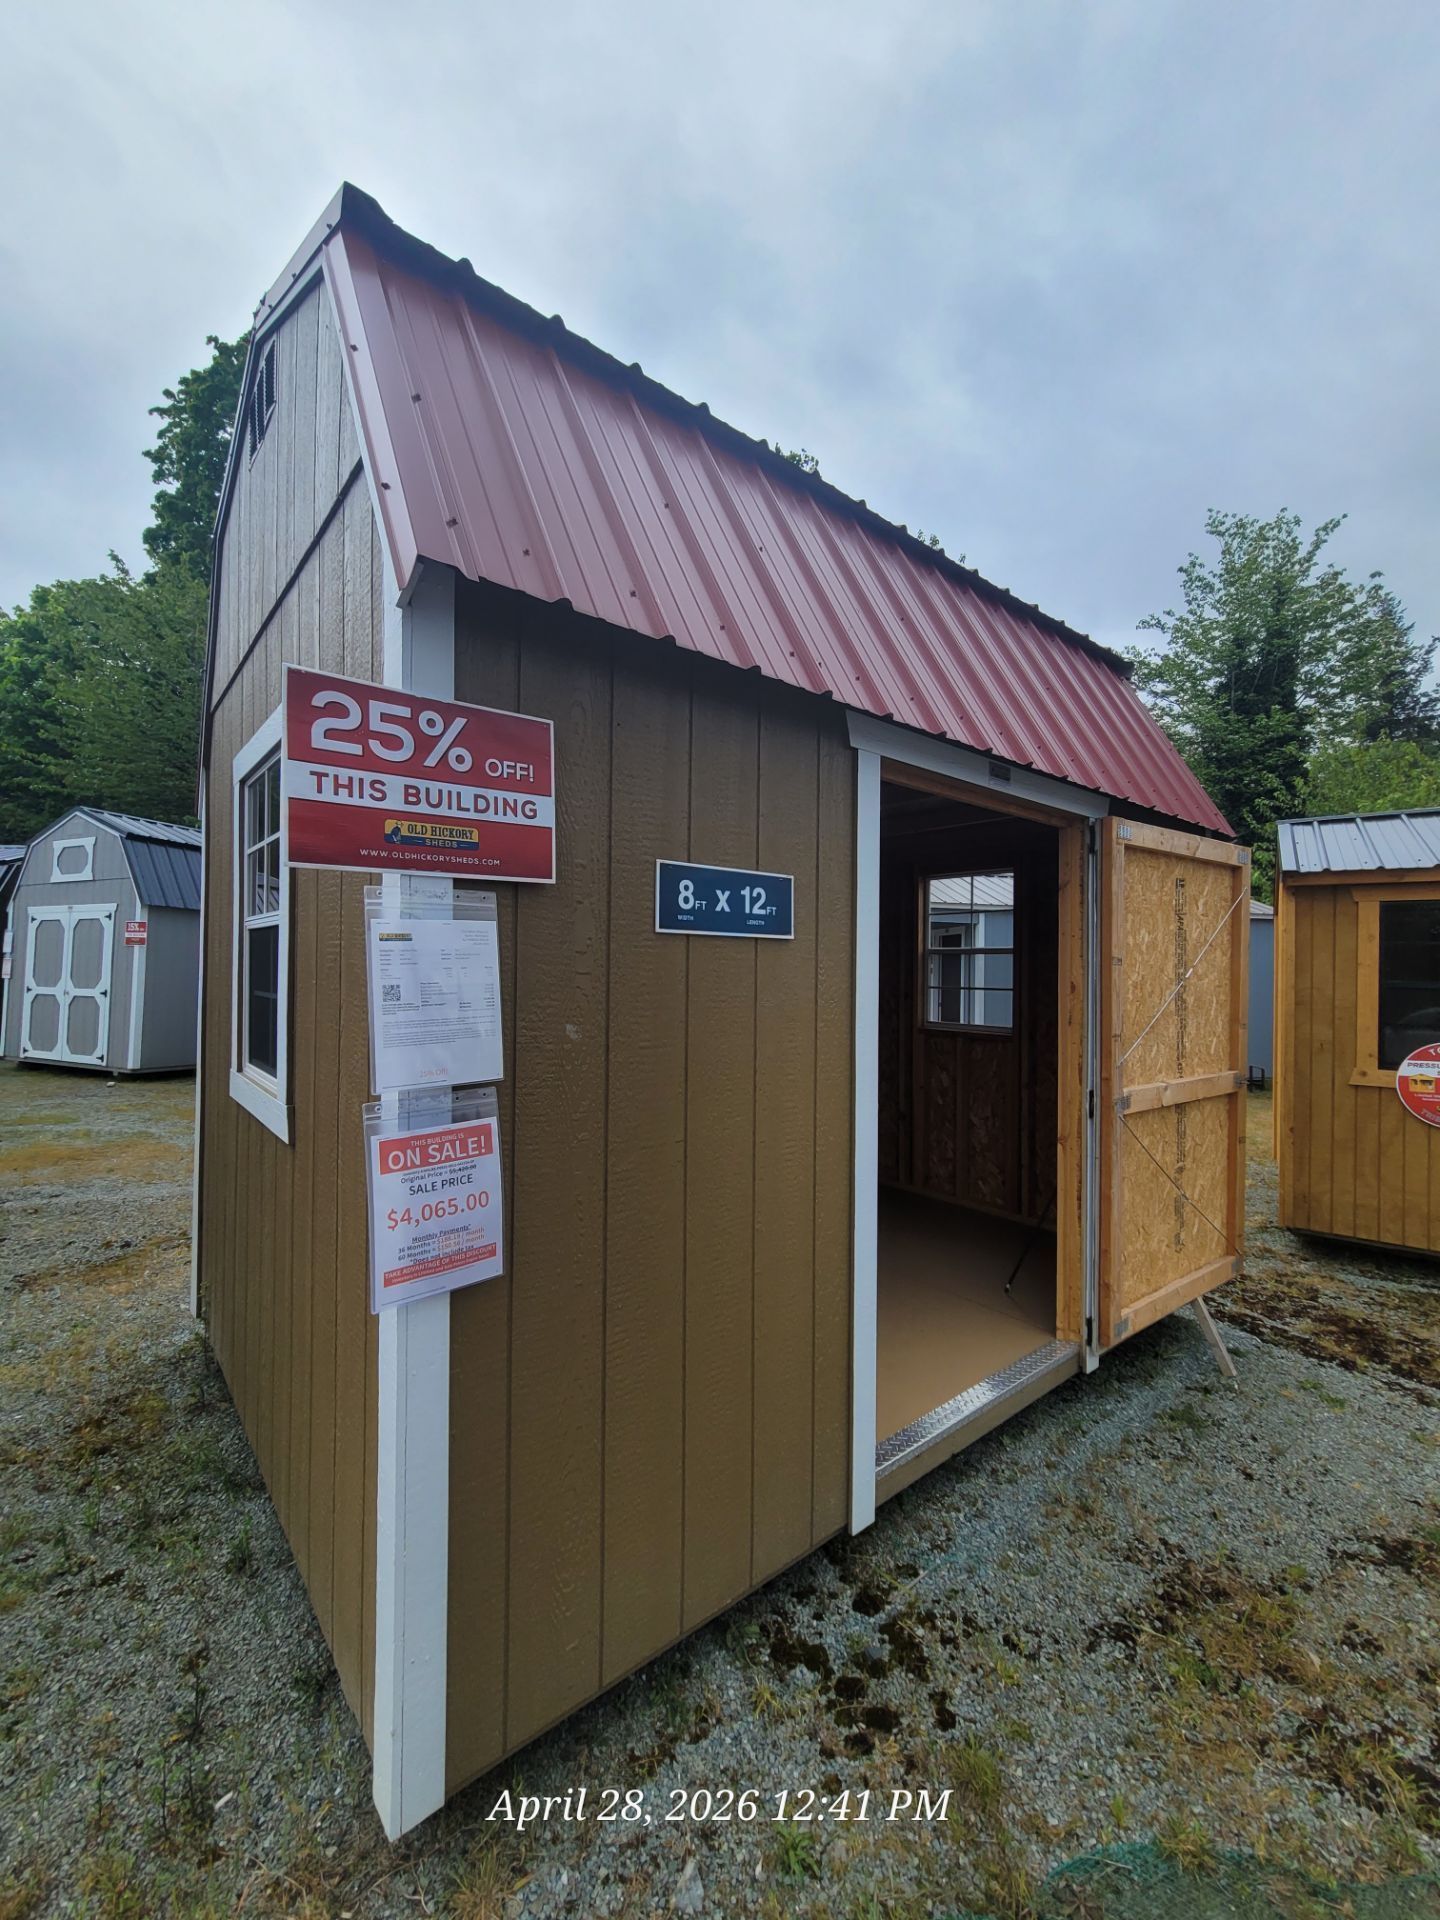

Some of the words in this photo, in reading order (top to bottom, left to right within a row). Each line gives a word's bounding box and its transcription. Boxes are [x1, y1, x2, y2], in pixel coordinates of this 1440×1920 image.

[311, 690, 473, 773] 25%
[485, 758, 535, 783] OFF!
[309, 770, 387, 801] THIS
[403, 784, 538, 819] BUILDING
[407, 823, 427, 836] OLD
[431, 825, 474, 840] HICKORY
[425, 839, 458, 848] SHEDS
[359, 849, 501, 865] WWW.OLDHICKORYSHEDS.COM
[411, 1139, 427, 1147] THIS
[427, 1133, 457, 1145] BUILDING
[388, 1147, 421, 1170] ON
[428, 1135, 486, 1163] SALE!
[400, 1173, 427, 1184] Original
[409, 1181, 438, 1196] SALE
[441, 1173, 473, 1190] PRICE
[386, 1190, 490, 1231] $4,065.00
[406, 1241, 431, 1251] Months
[465, 1227, 485, 1236] month
[407, 1249, 431, 1259] Months
[465, 1234, 485, 1243] month
[412, 1232, 438, 1243] Monthly
[385, 1271, 402, 1279] TAKE
[402, 1261, 441, 1274] ADVANTAGE
[450, 1252, 466, 1263] THIS
[466, 1244, 496, 1258] DISCOUNT
